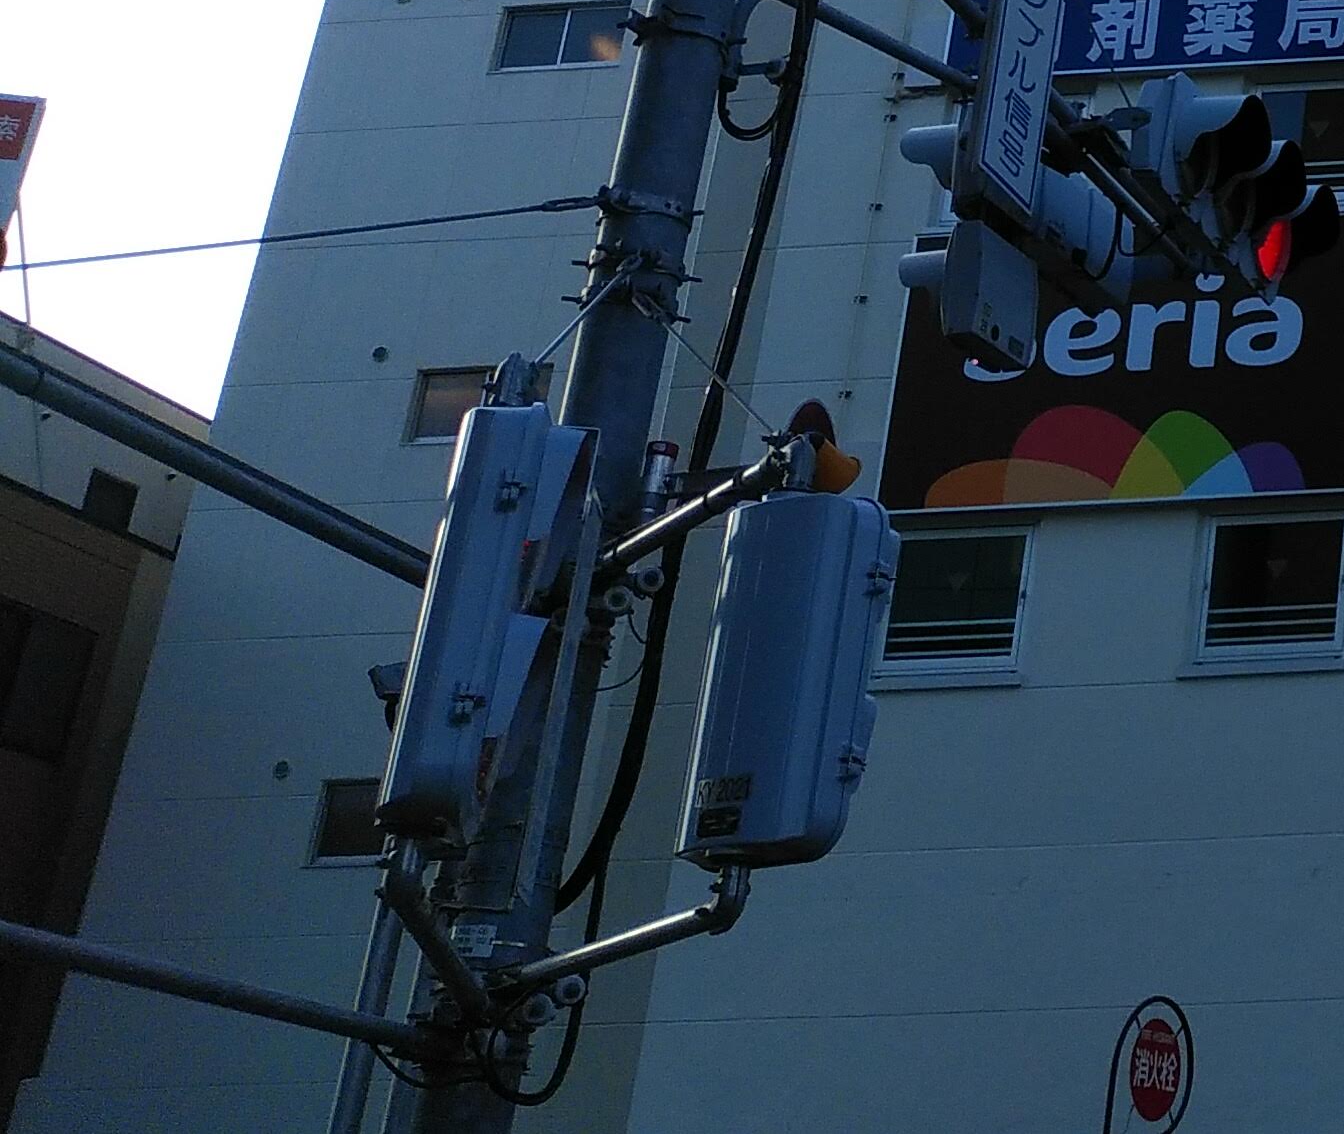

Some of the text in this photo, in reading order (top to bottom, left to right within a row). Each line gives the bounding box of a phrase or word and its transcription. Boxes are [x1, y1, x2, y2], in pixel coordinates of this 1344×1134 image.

[963, 273, 1304, 382] eria
[1133, 1048, 1178, 1092] 消火栓
